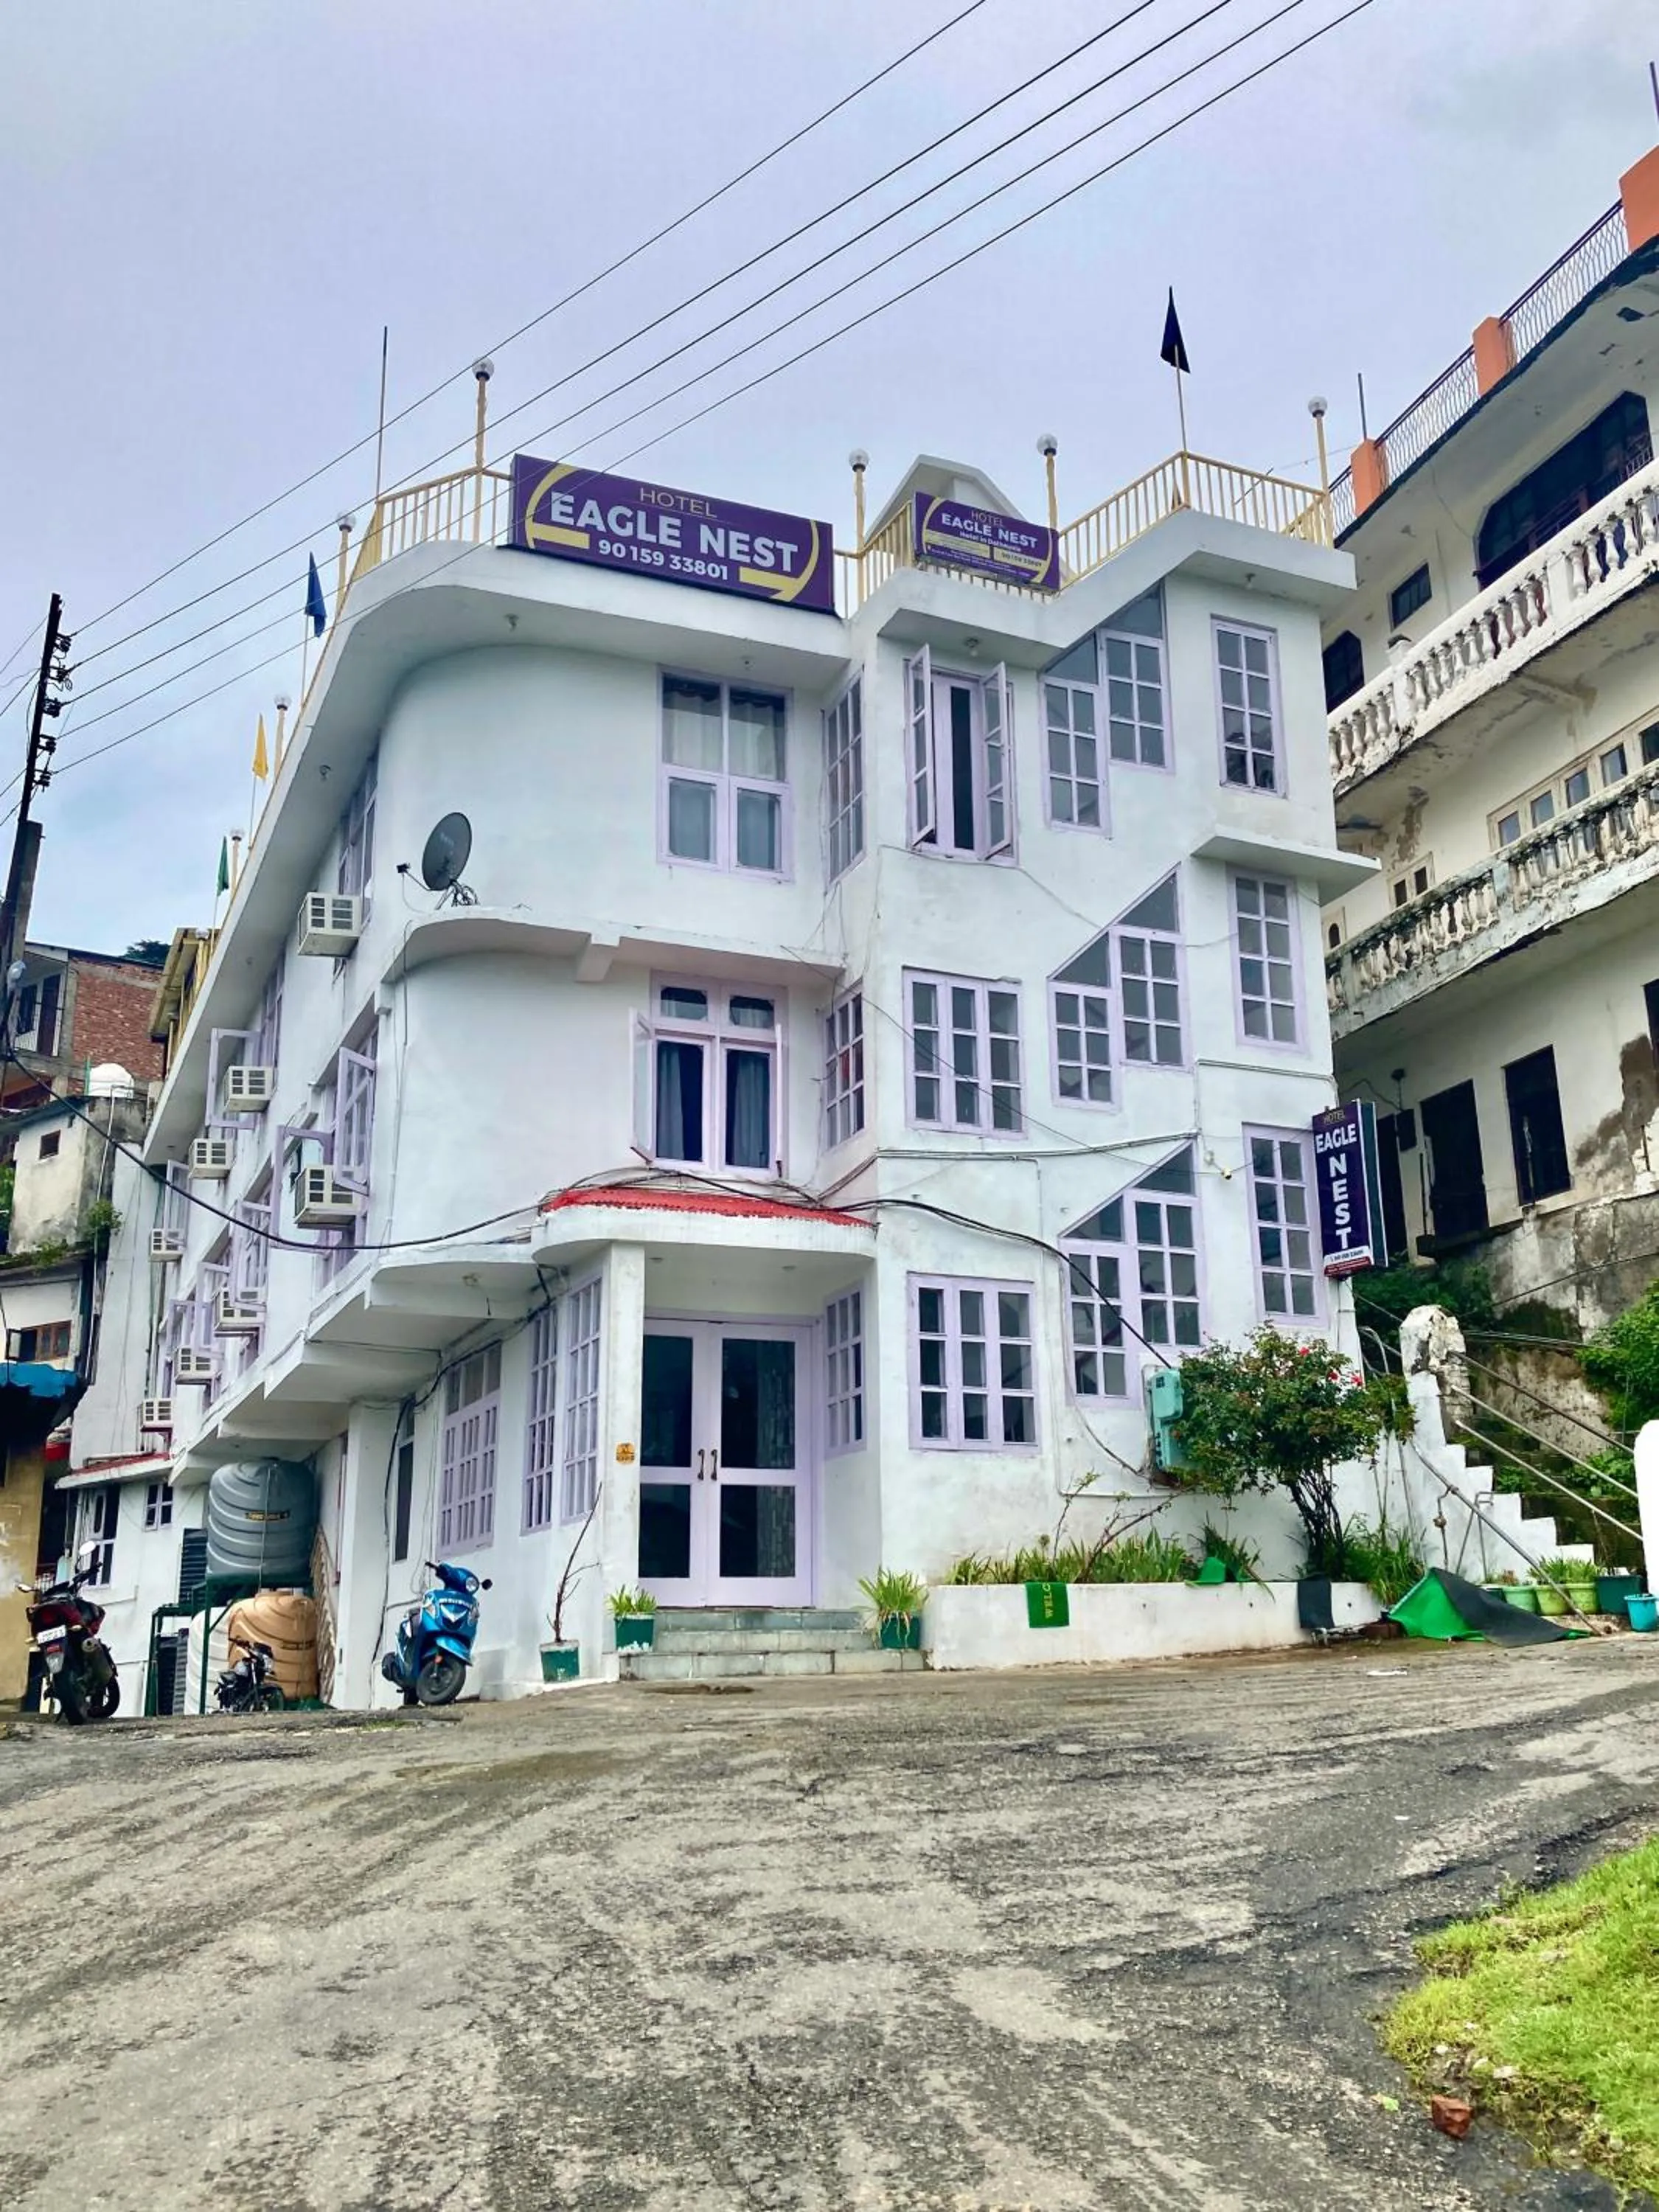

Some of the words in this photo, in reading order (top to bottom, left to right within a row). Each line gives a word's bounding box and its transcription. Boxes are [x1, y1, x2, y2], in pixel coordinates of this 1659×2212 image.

[639, 487, 717, 518] HOTEL
[970, 509, 1004, 527] HOTEL
[550, 491, 682, 549] EAGLE
[700, 524, 799, 572] NEST
[941, 512, 992, 537] EAGLE
[998, 528, 1038, 549] NEST
[669, 554, 728, 580] 33801
[1315, 1123, 1357, 1154] EAGLE
[1329, 1153, 1352, 1250] NEST
